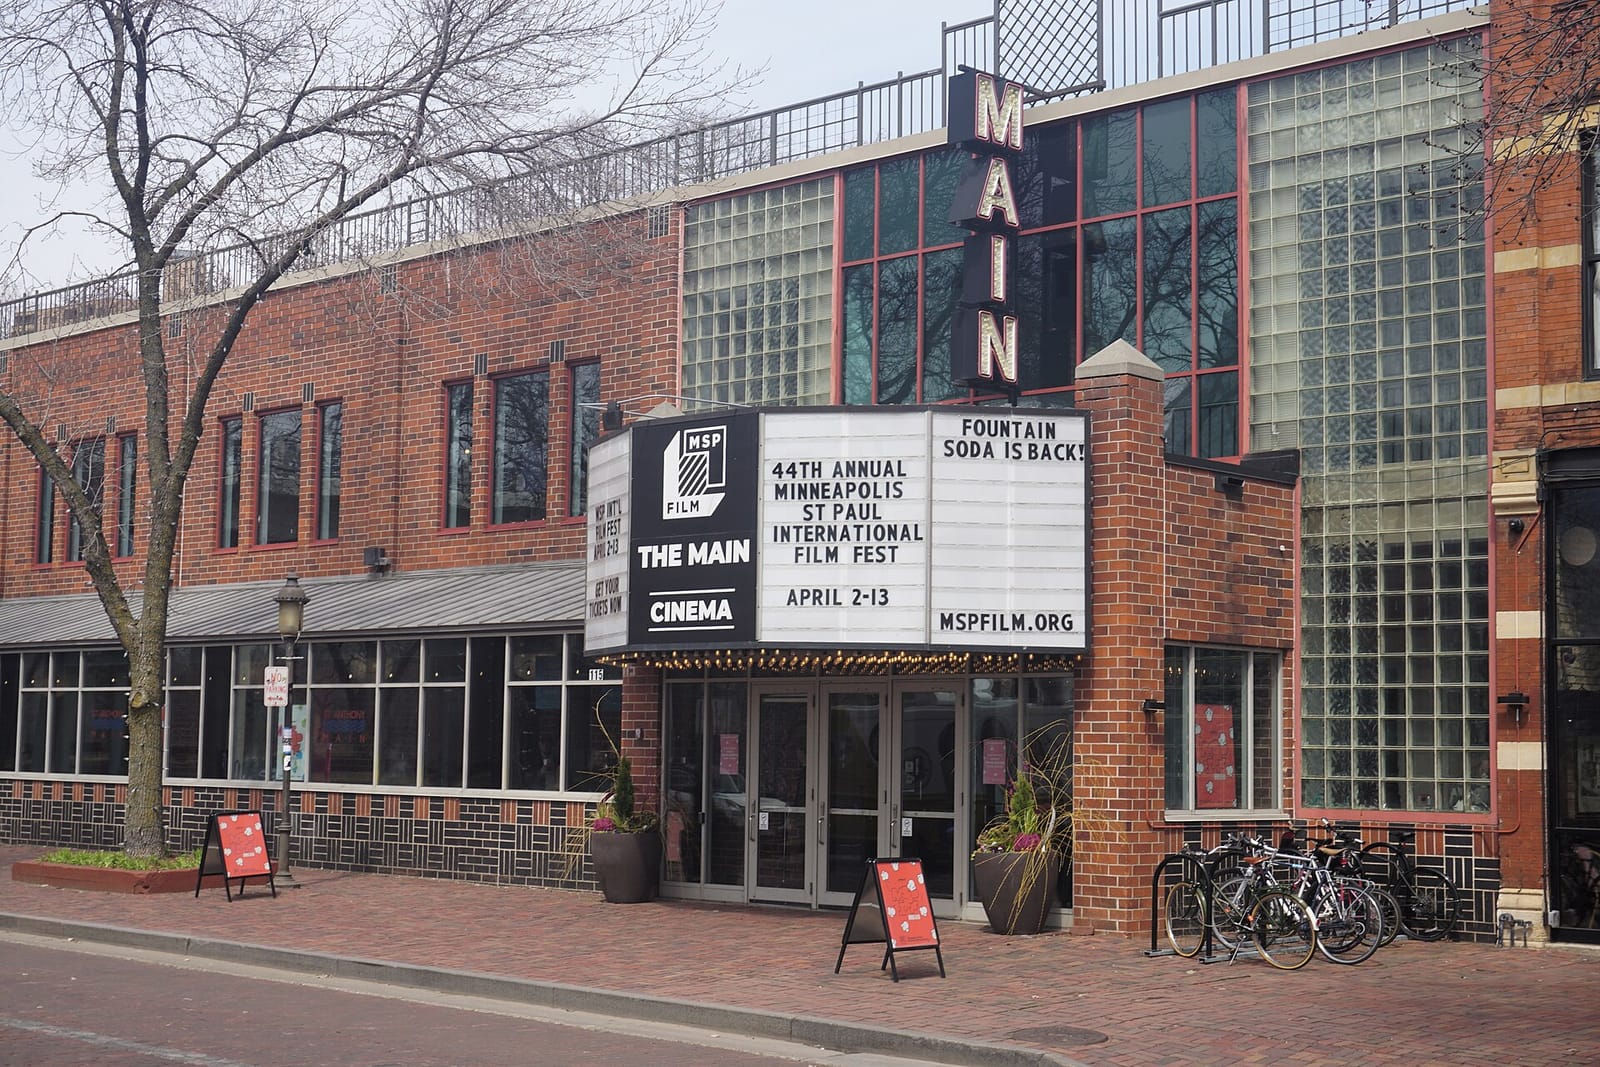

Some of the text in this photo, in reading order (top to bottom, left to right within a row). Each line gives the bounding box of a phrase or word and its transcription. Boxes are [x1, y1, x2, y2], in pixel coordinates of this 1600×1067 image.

[975, 73, 1024, 384] MAIN
[962, 418, 1056, 440] FOUNTAIN
[689, 433, 721, 450] MSP
[944, 439, 1084, 461] SODA IS BACK!
[772, 460, 907, 479] 44TH ANNUAL
[775, 481, 904, 500] MINNEAPOLIS
[667, 500, 700, 514] FILM
[803, 503, 882, 521] ST PAUL
[596, 518, 621, 540] FILM FEST
[773, 524, 924, 543] INTERNATIONAL
[637, 539, 751, 569] THE MAIN
[794, 545, 899, 564] FILM FEST
[595, 576, 619, 598] GET YOUR
[786, 588, 889, 606] APRIL 2-13
[589, 596, 622, 618] TICKETS NOW
[650, 599, 733, 623] CINEMA
[940, 613, 1074, 632] MSPFILM.ORG
[270, 672, 282, 683] NO
[589, 669, 604, 681] 115
[265, 685, 287, 694] PARKING
